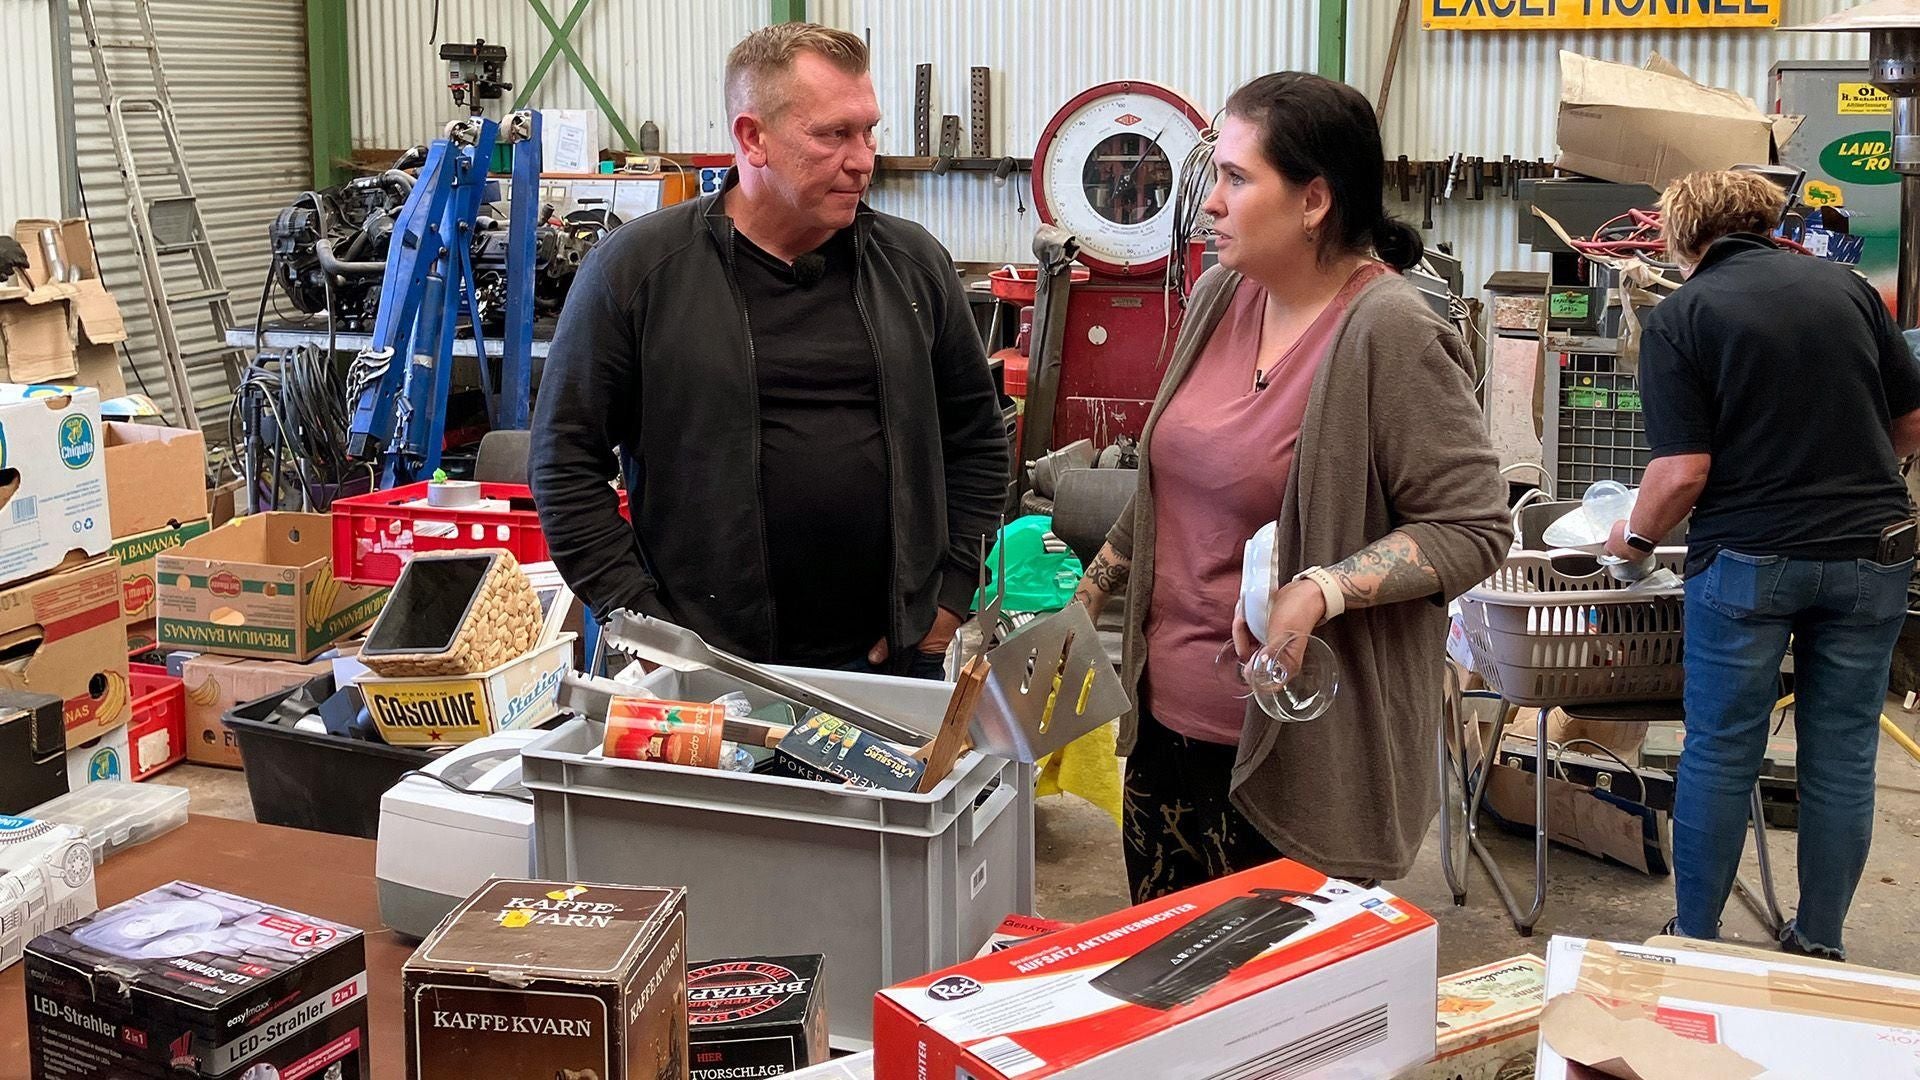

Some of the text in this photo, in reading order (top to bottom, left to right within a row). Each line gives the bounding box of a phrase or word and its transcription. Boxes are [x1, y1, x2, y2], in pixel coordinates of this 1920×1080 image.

[1838, 142, 1885, 155] LAND
[1864, 157, 1890, 170] RO
[61, 441, 94, 460] Chiquita
[129, 533, 181, 559] BANANAS
[164, 623, 290, 648] PREMIUM BANANAS
[374, 692, 480, 728] GASOLINE
[863, 748, 916, 778] KARLSBERG
[1016, 902, 1197, 974] AUFSATZ-AKTENVERNICHTER
[170, 958, 253, 985] LED-Strahler
[931, 978, 976, 999] Rex
[33, 994, 117, 1039] LED-Strahler
[229, 1000, 326, 1063] LED-Strahler
[696, 1052, 723, 1063] HIER
